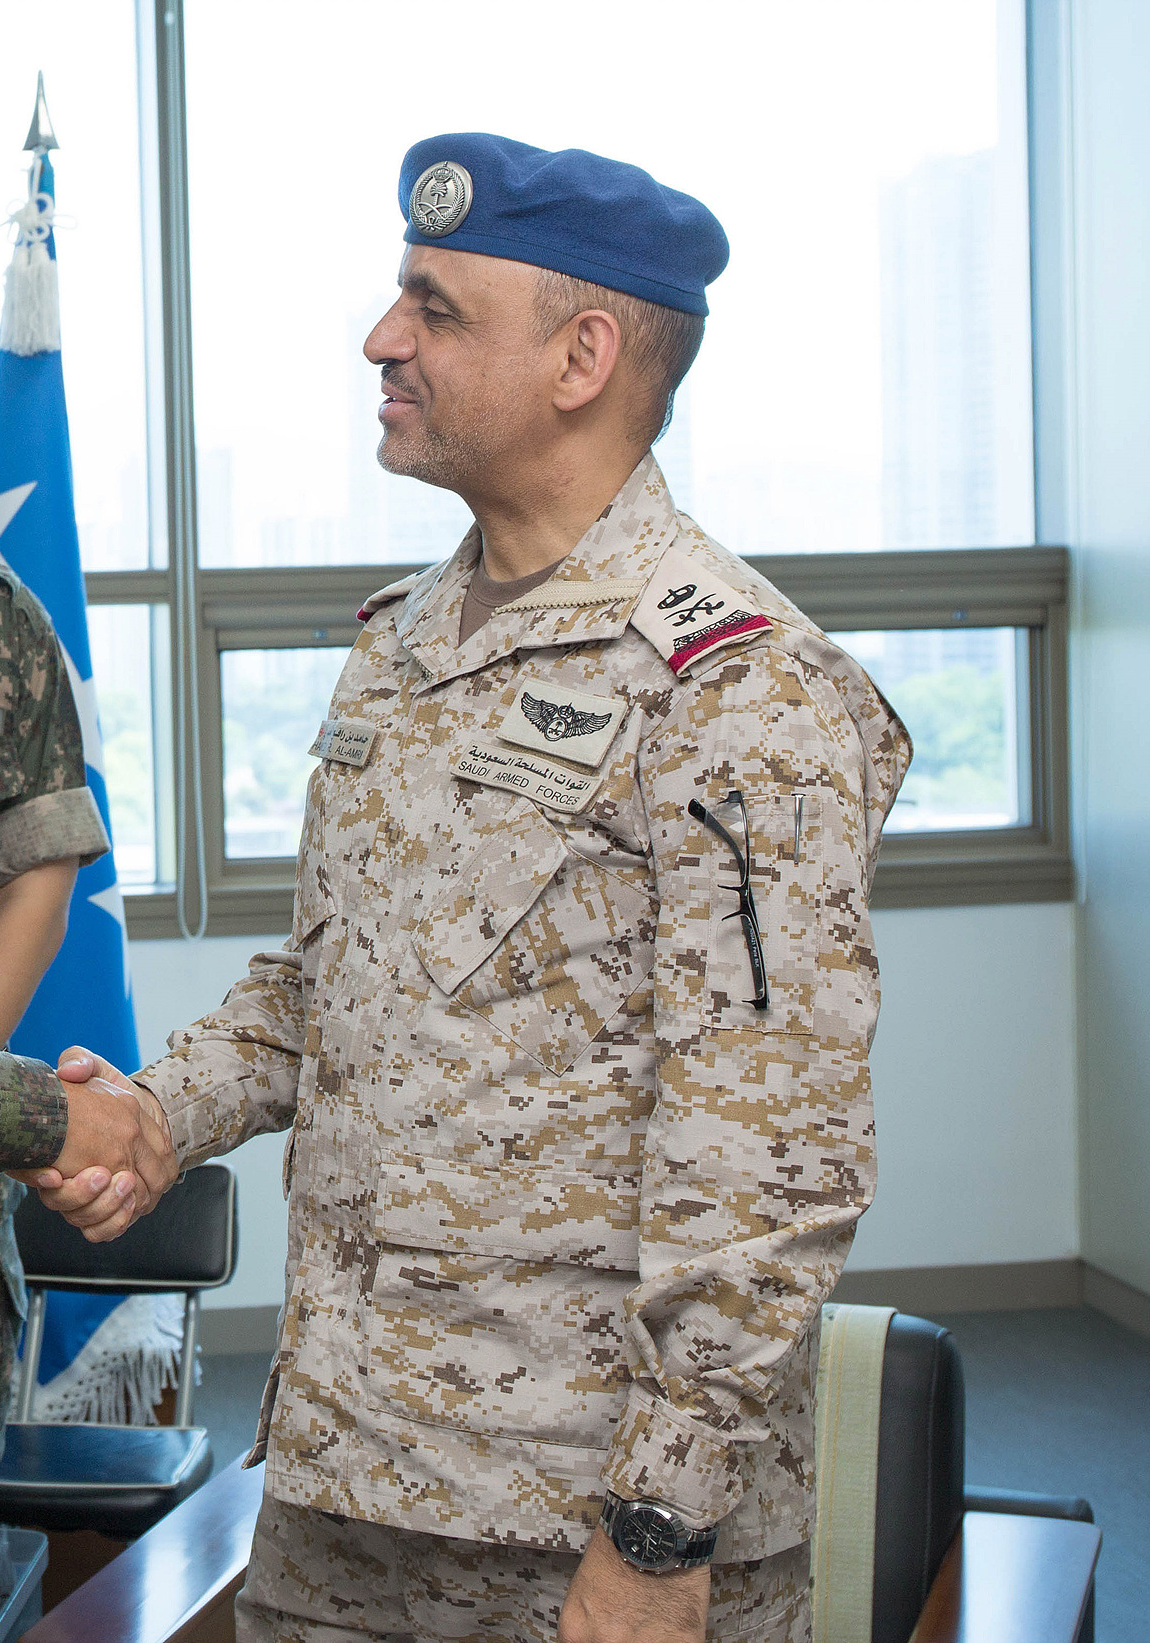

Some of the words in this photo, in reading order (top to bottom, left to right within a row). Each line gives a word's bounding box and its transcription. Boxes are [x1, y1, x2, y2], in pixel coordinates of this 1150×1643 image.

[468, 745, 515, 767] السعودية
[514, 756, 555, 780] المسلحة
[458, 760, 491, 778] SAUDI
[493, 771, 530, 789] ARMED
[535, 784, 580, 807] FORCES
[554, 773, 591, 792] القوات
